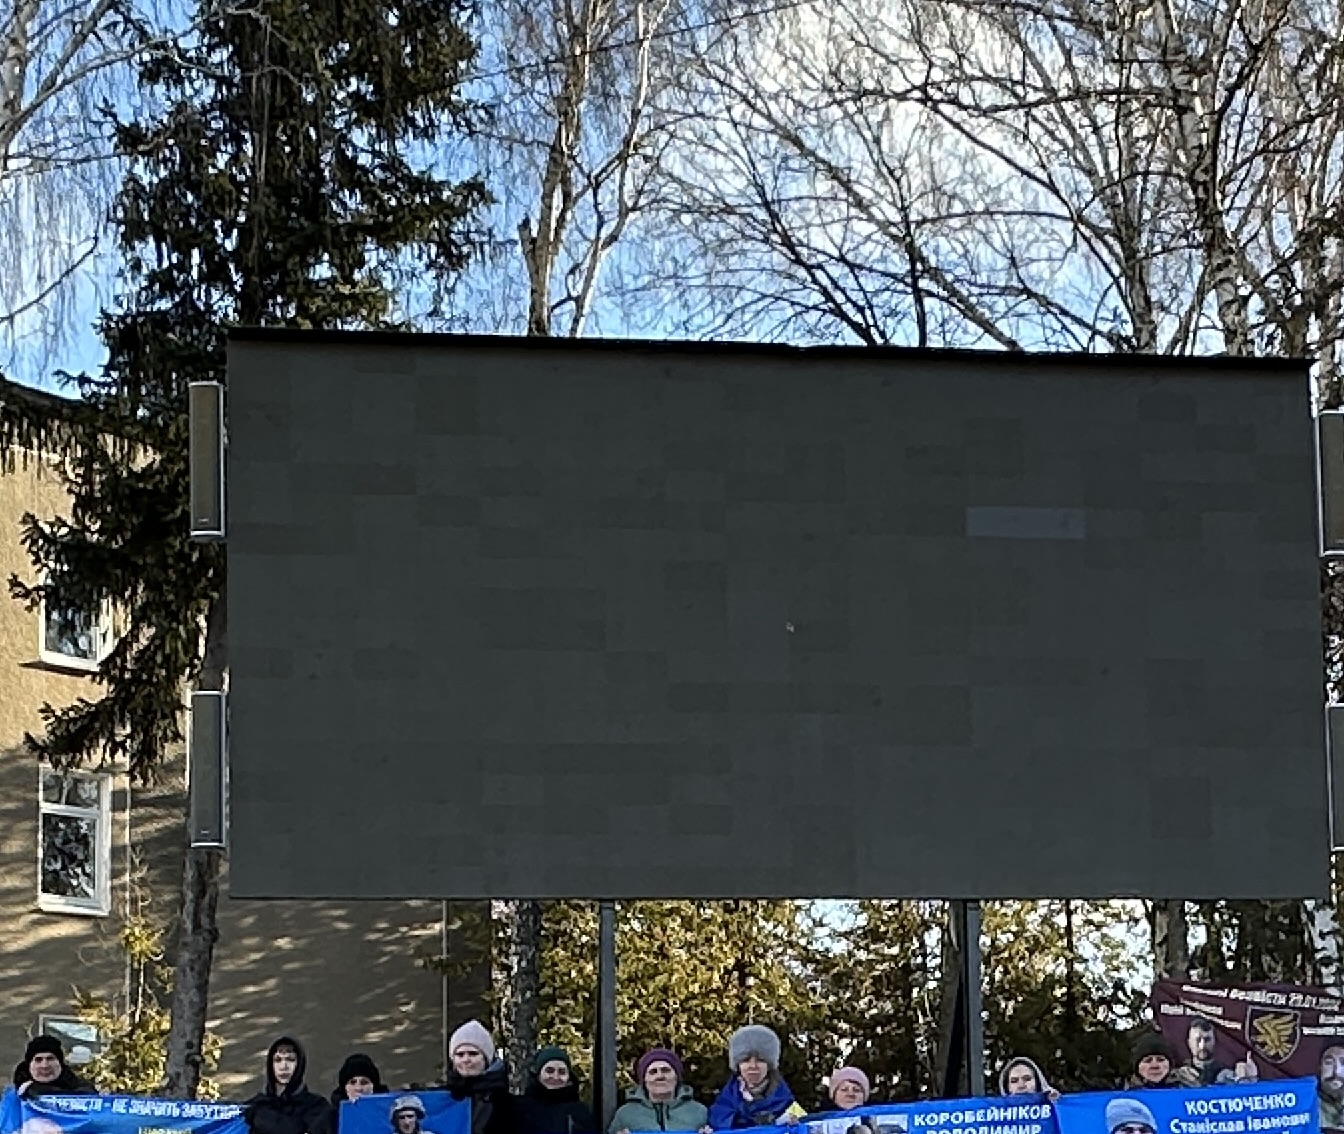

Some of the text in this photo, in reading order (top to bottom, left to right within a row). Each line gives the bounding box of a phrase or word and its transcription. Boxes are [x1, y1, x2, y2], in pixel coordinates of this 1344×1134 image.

[914, 1104, 1053, 1126] КОРОБЕЙНІКОВ
[1185, 1092, 1296, 1116] КОСТЮЧЕНКО
[1170, 1116, 1245, 1134] Станіслав
